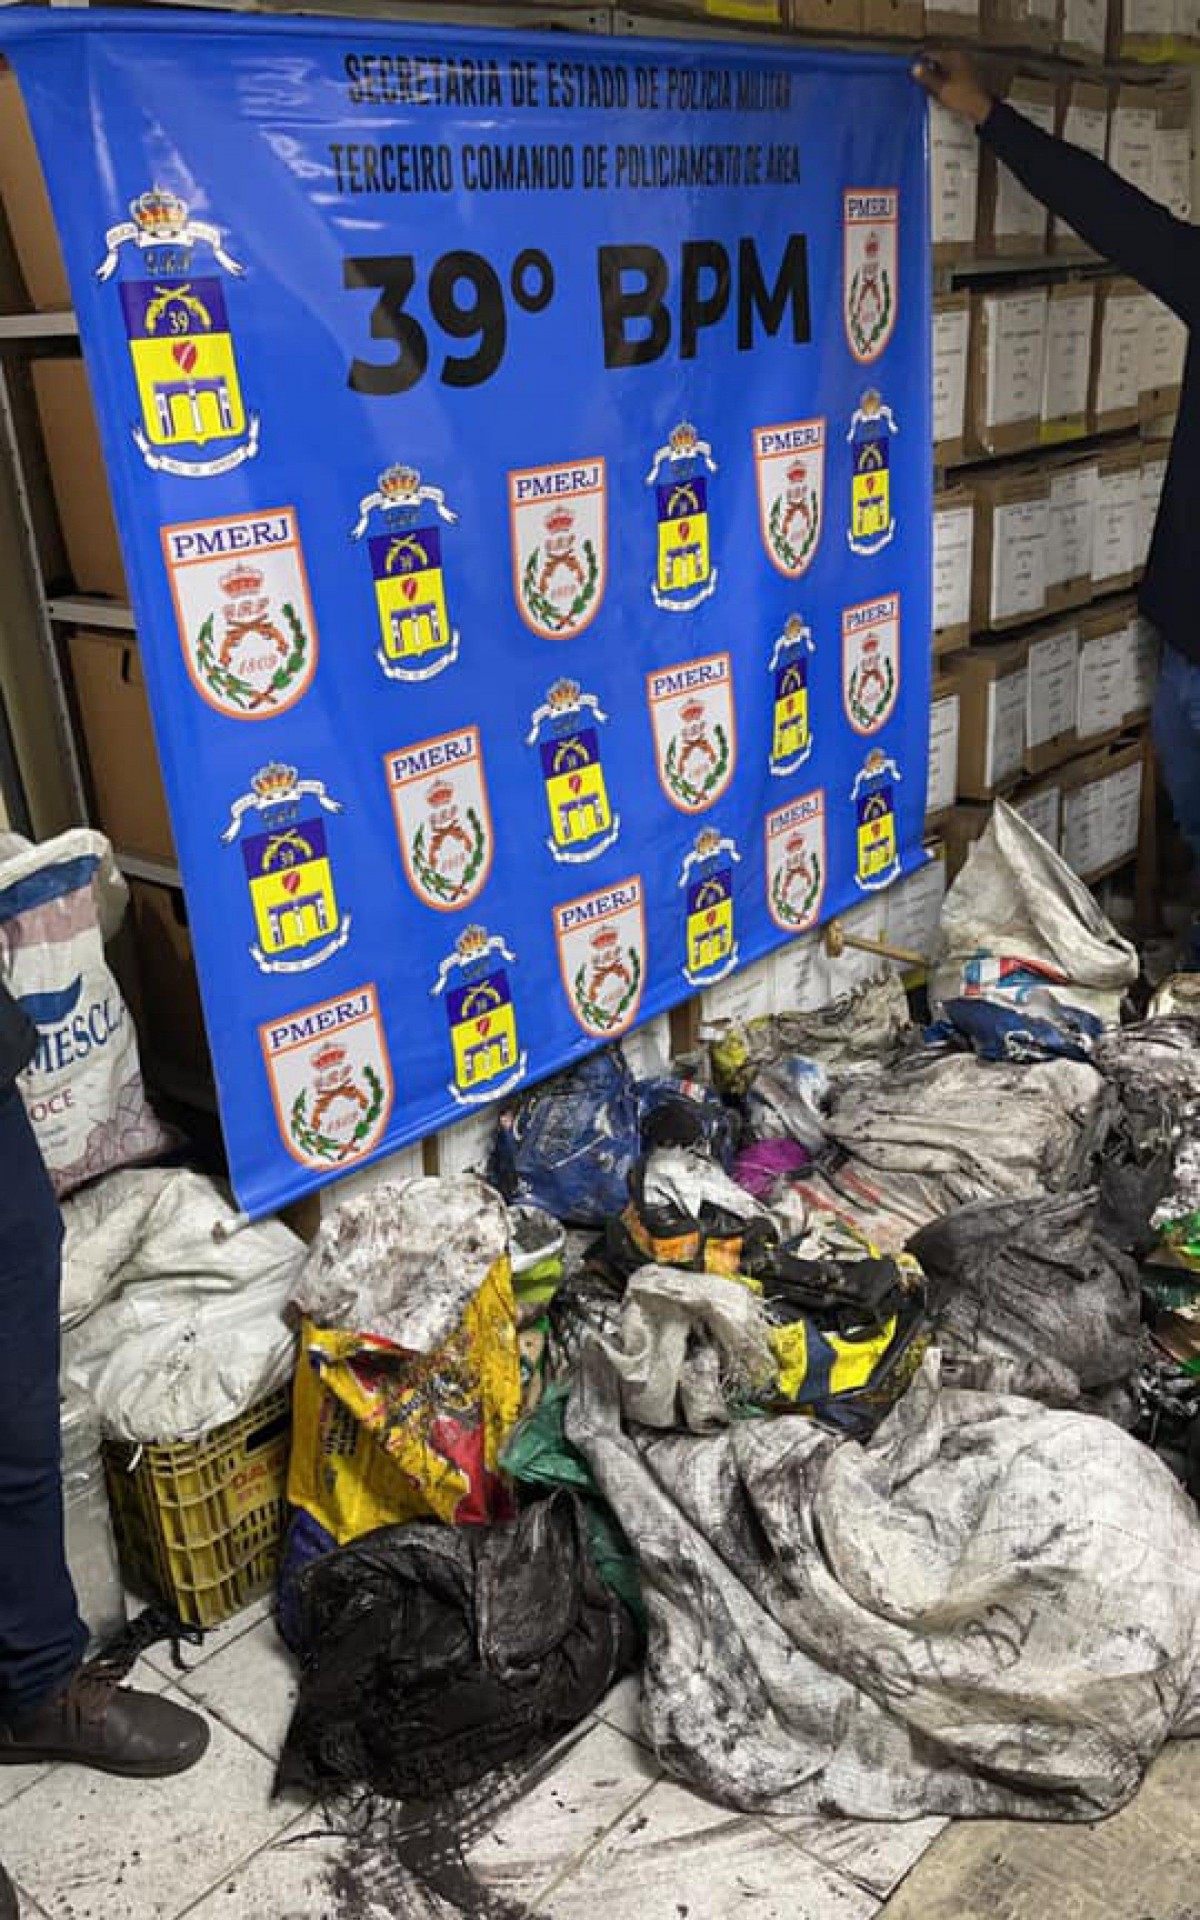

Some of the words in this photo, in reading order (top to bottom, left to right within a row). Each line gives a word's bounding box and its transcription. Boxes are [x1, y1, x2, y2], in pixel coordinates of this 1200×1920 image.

[344, 53, 501, 106] SECRETARIA
[510, 60, 539, 107] DE
[546, 61, 628, 108] ESTADO
[636, 65, 659, 109] DE
[330, 143, 453, 194] TERCEIRO
[462, 143, 573, 192] COMANDO
[583, 143, 608, 189] DE
[615, 143, 740, 188] POLICIAMENTO
[849, 197, 893, 218] PMERJ
[597, 233, 811, 369] BPM
[168, 309, 190, 335] 39
[762, 426, 821, 454] PMERJ
[516, 467, 599, 499] PMERJ
[173, 517, 288, 559] PMERJ
[848, 601, 895, 630] PMERJ
[654, 661, 725, 696] PMERJ
[392, 736, 472, 780] PMERJ
[771, 796, 819, 833] PMERJ
[561, 886, 637, 928] PMERJ
[270, 995, 368, 1049] PMERJ
